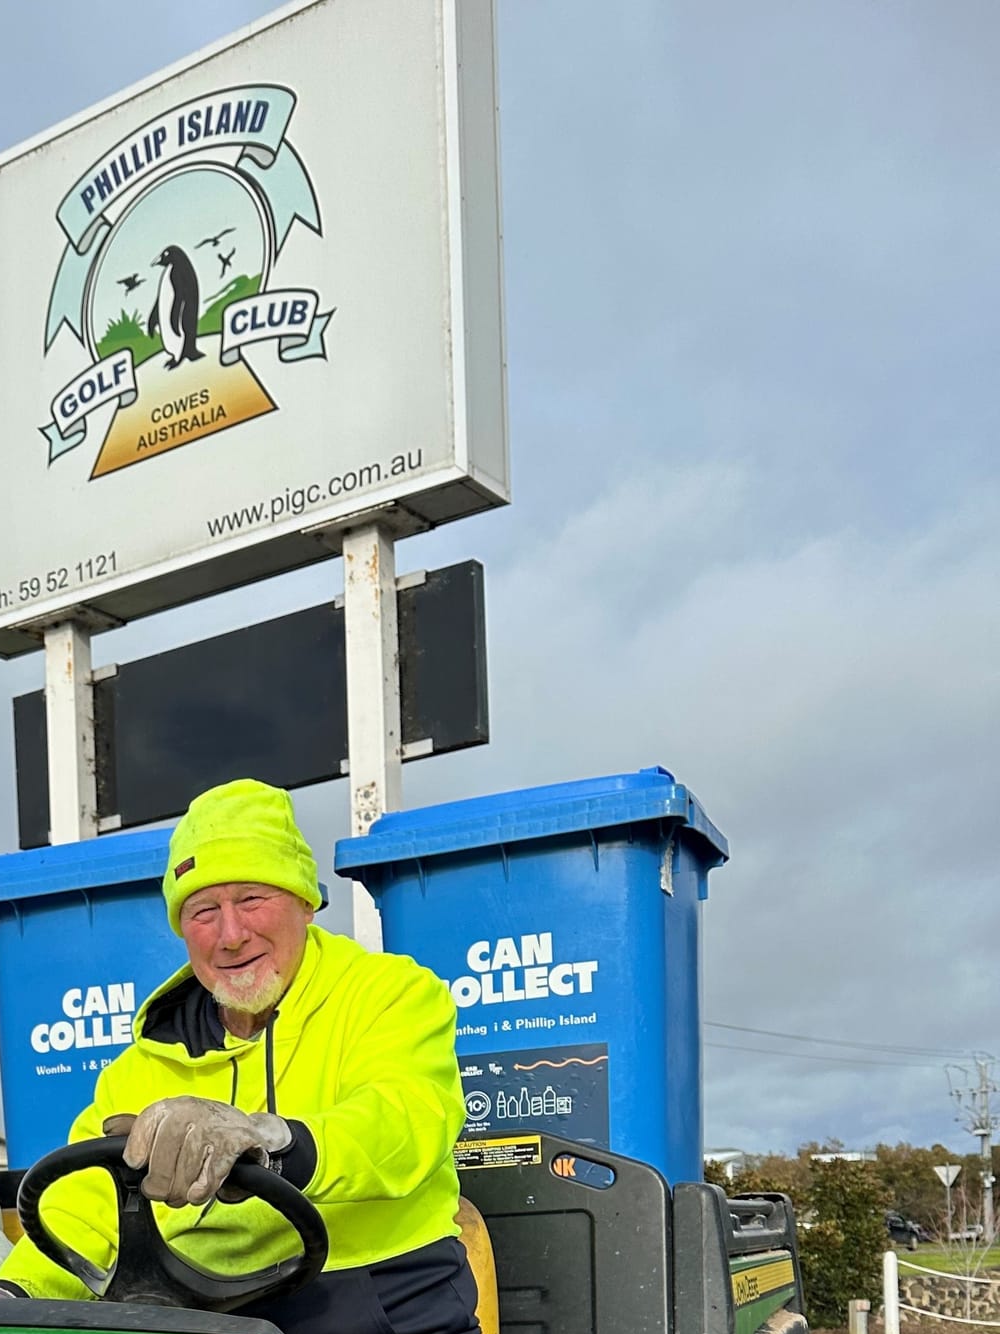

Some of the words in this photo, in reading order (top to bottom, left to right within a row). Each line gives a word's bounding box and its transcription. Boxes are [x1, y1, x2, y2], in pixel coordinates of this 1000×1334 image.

[80, 126, 167, 215] PHILLIP
[178, 100, 270, 147] ISLAND
[60, 359, 128, 418] GOLF
[230, 300, 309, 335] CLUB
[151, 389, 210, 423] COWES
[136, 405, 227, 451] AUSTRALIA
[207, 448, 423, 538] www.pigc.com.au
[18, 574, 41, 601] 59
[46, 569, 69, 594] 52
[75, 551, 118, 583] 1121
[466, 932, 553, 973] CAN
[62, 982, 135, 1018] CAN
[441, 961, 598, 1008] OLLECT
[30, 1014, 133, 1053] COLLE
[501, 1020, 512, 1032] &
[516, 1016, 556, 1030] Phillip
[560, 1012, 597, 1026] Island
[89, 1060, 98, 1071] &
